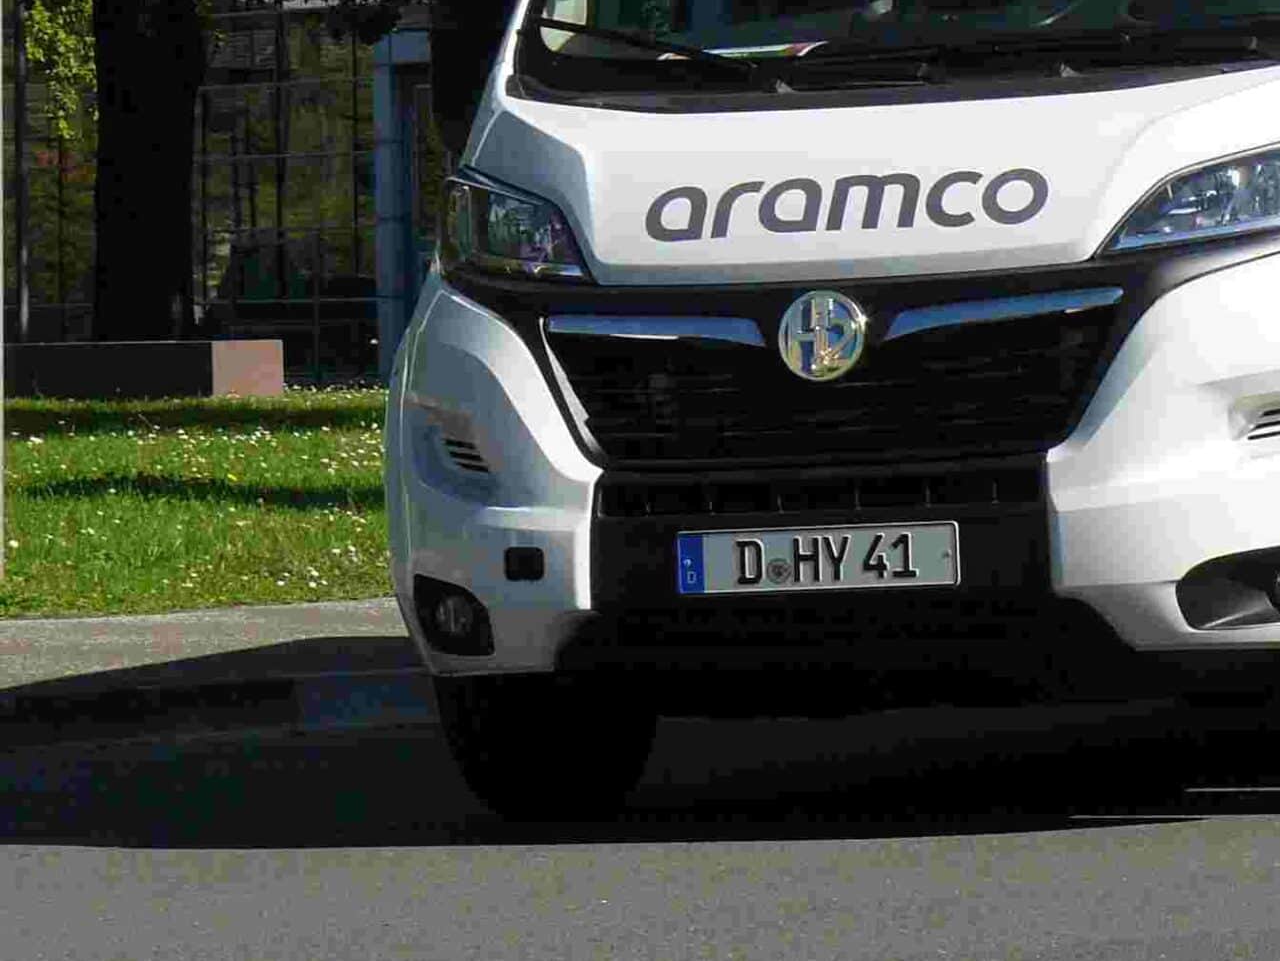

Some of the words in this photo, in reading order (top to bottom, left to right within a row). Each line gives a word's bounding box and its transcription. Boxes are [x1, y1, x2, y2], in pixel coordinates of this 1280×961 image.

[645, 168, 1049, 243] aramco
[736, 538, 764, 585] D
[793, 534, 852, 582] HY
[863, 532, 919, 579] 41
